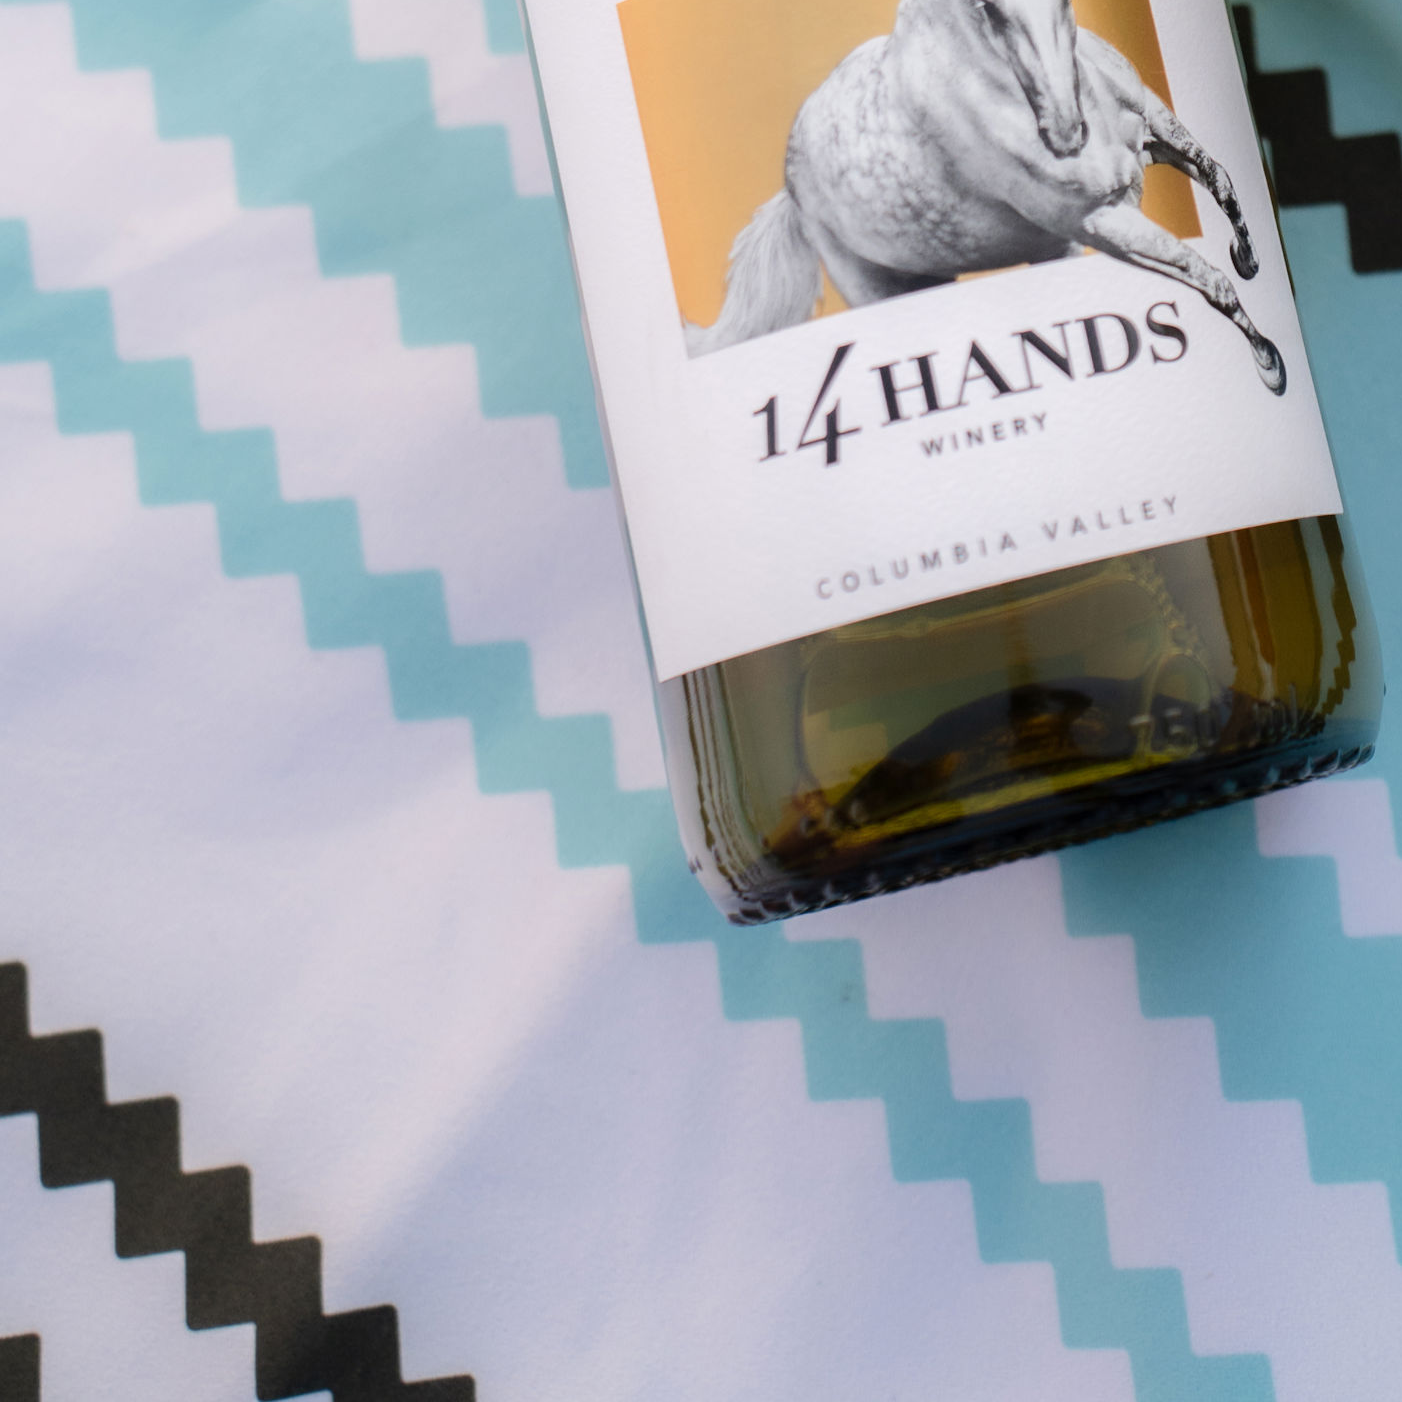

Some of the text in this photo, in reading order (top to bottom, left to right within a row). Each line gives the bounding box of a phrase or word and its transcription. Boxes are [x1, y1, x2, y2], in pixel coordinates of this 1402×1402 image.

[752, 300, 1189, 468] 14 HANDS
[919, 412, 1047, 458] WINERY
[816, 495, 1178, 600] COLUMBIA VALLEY
